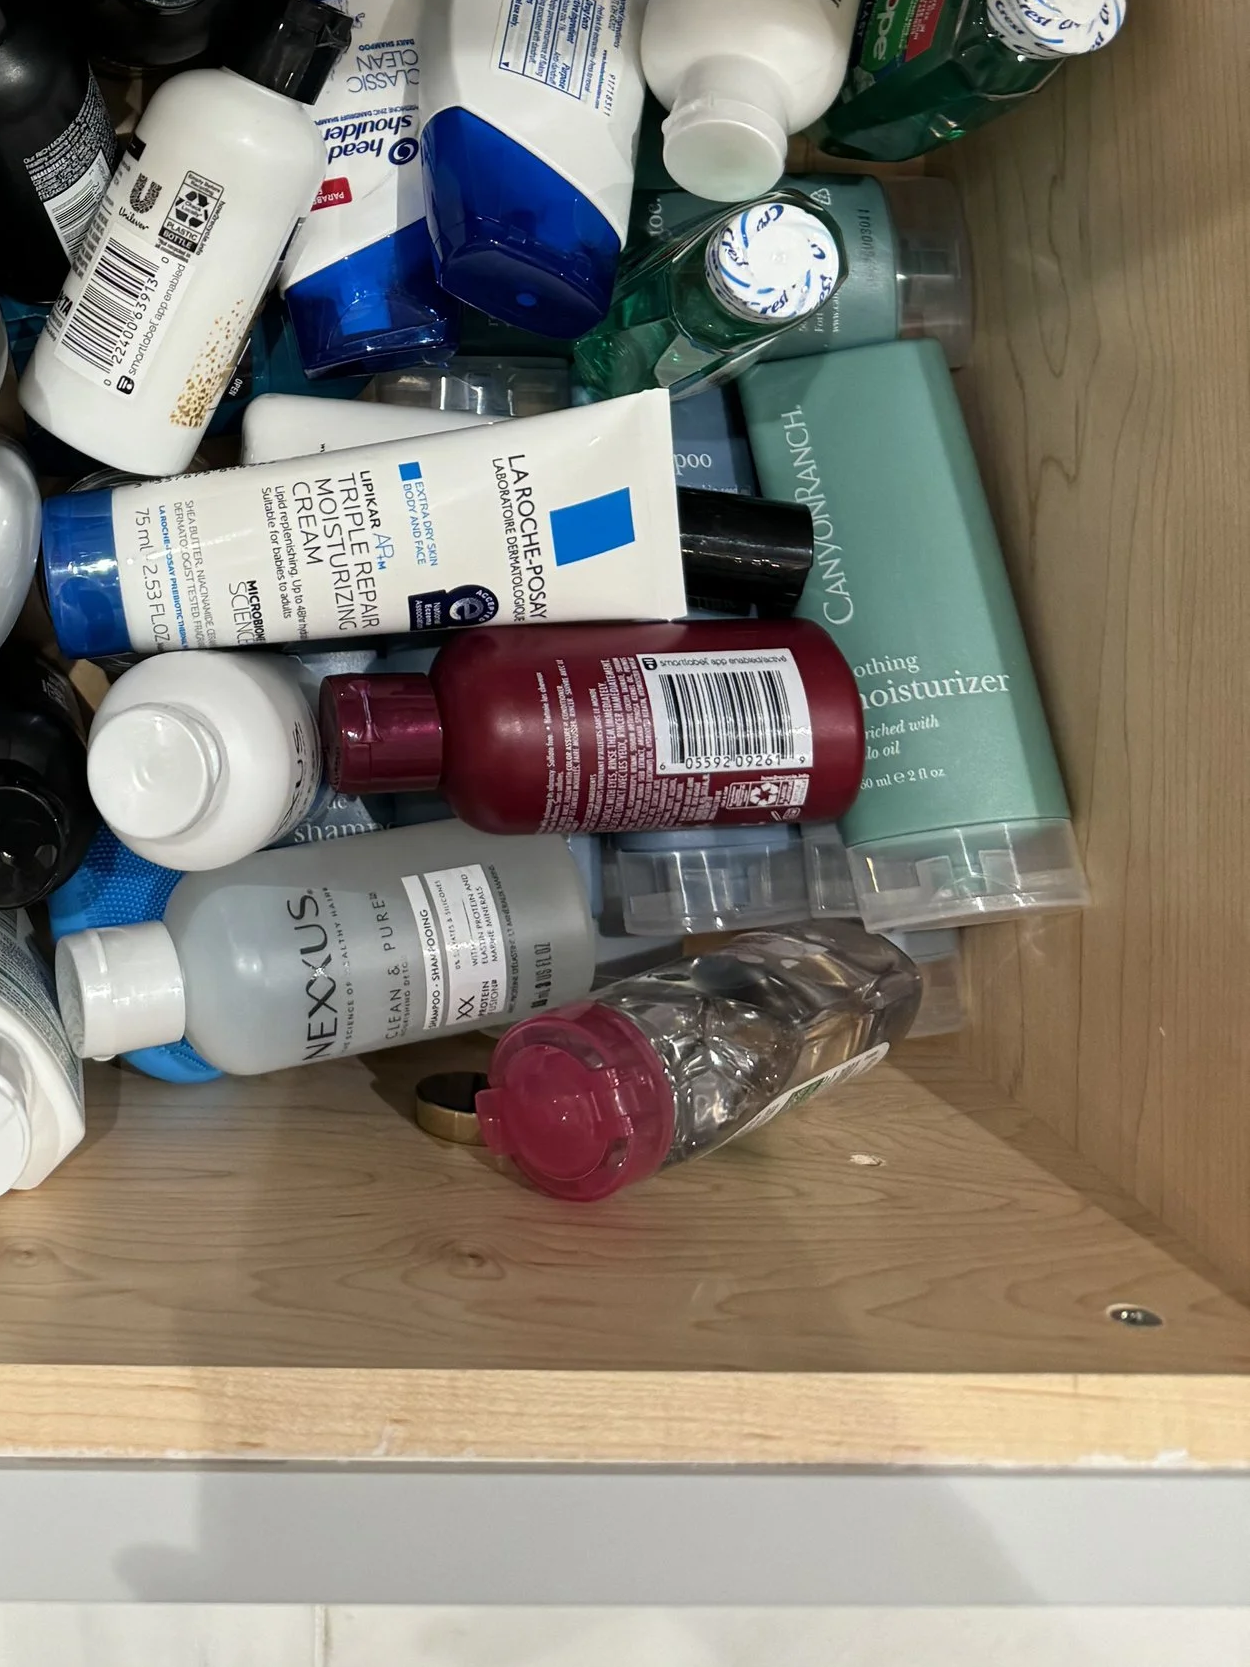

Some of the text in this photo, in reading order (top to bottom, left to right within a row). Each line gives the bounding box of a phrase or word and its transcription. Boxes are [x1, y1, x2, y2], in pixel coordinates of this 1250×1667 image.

[345, 68, 418, 90] CLASSIC
[355, 49, 418, 68] CLEAN
[324, 114, 410, 139] shoulder
[328, 138, 382, 163] head
[161, 262, 186, 301] enabled
[111, 276, 159, 364] 22400 63913
[153, 301, 171, 322] app
[291, 480, 322, 565] CREAM
[359, 469, 380, 528] LIPIKAR
[402, 483, 426, 564] BODY AND FACE
[413, 480, 438, 566] EXTRA DRY SKIN
[133, 507, 162, 600] 75 ml 2.53
[260, 486, 294, 619] Suitable for babies to adults
[312, 477, 358, 631] MOISTURIZING
[336, 472, 381, 629] TRIPLE REPAIR
[491, 457, 530, 622] LABORATOIRE DERMATOLOGIQUE
[506, 454, 554, 621] LA ROCHE-POSAY
[851, 650, 920, 682] othing
[881, 739, 901, 756] oil
[907, 713, 940, 731] with
[685, 751, 780, 771] 05592 09261
[385, 988, 399, 1038] CLEAN
